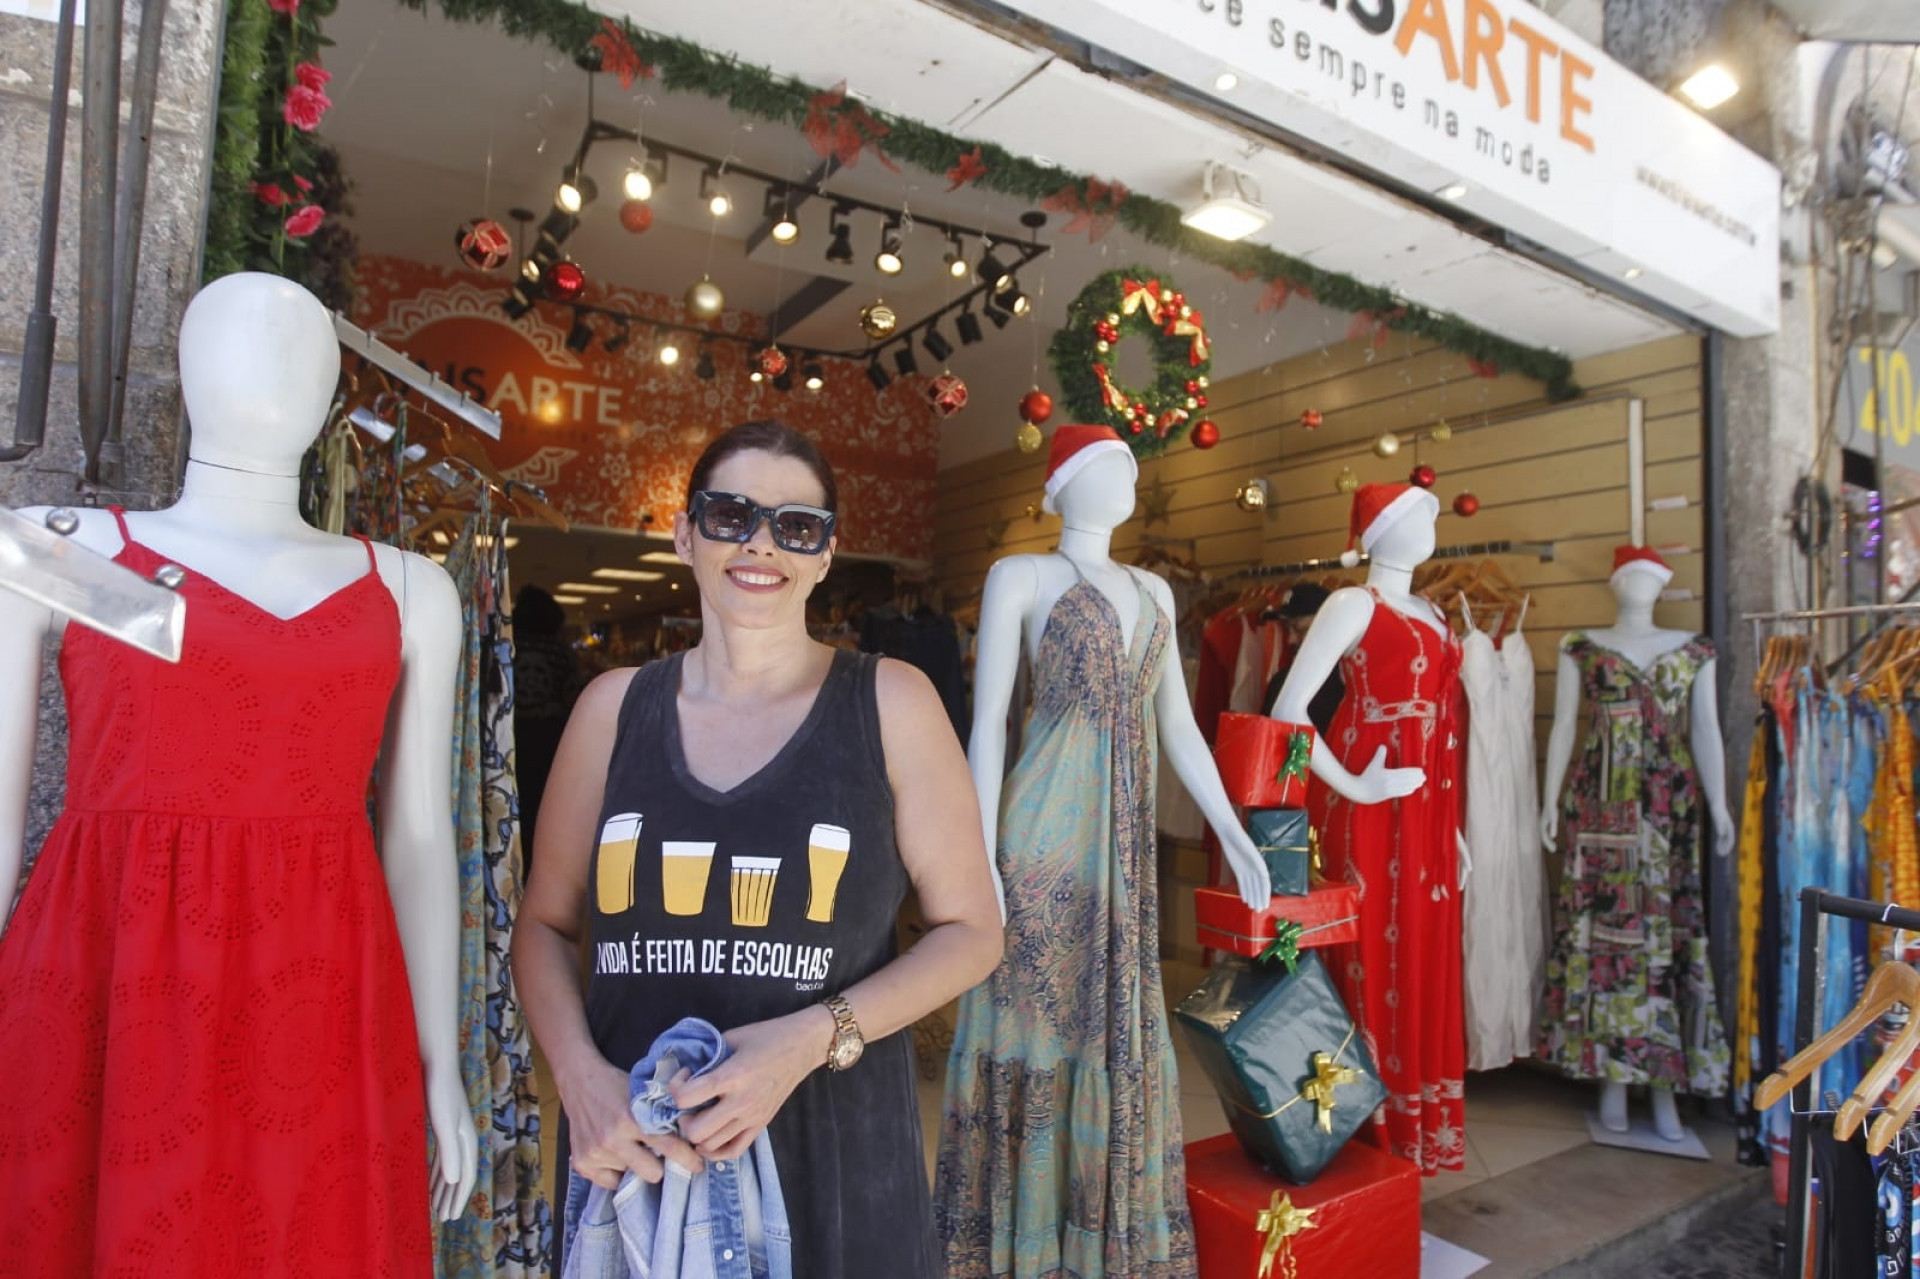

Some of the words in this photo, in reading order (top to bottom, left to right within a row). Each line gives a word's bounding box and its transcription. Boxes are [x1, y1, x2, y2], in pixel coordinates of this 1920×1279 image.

[1269, 17, 1406, 109] sempre
[1425, 99, 1459, 137] na
[1475, 126, 1550, 183] moda
[632, 932, 642, 974] É
[646, 939, 696, 974] FEITA
[701, 939, 727, 974] DE
[731, 940, 834, 980] ESCOLHAS
